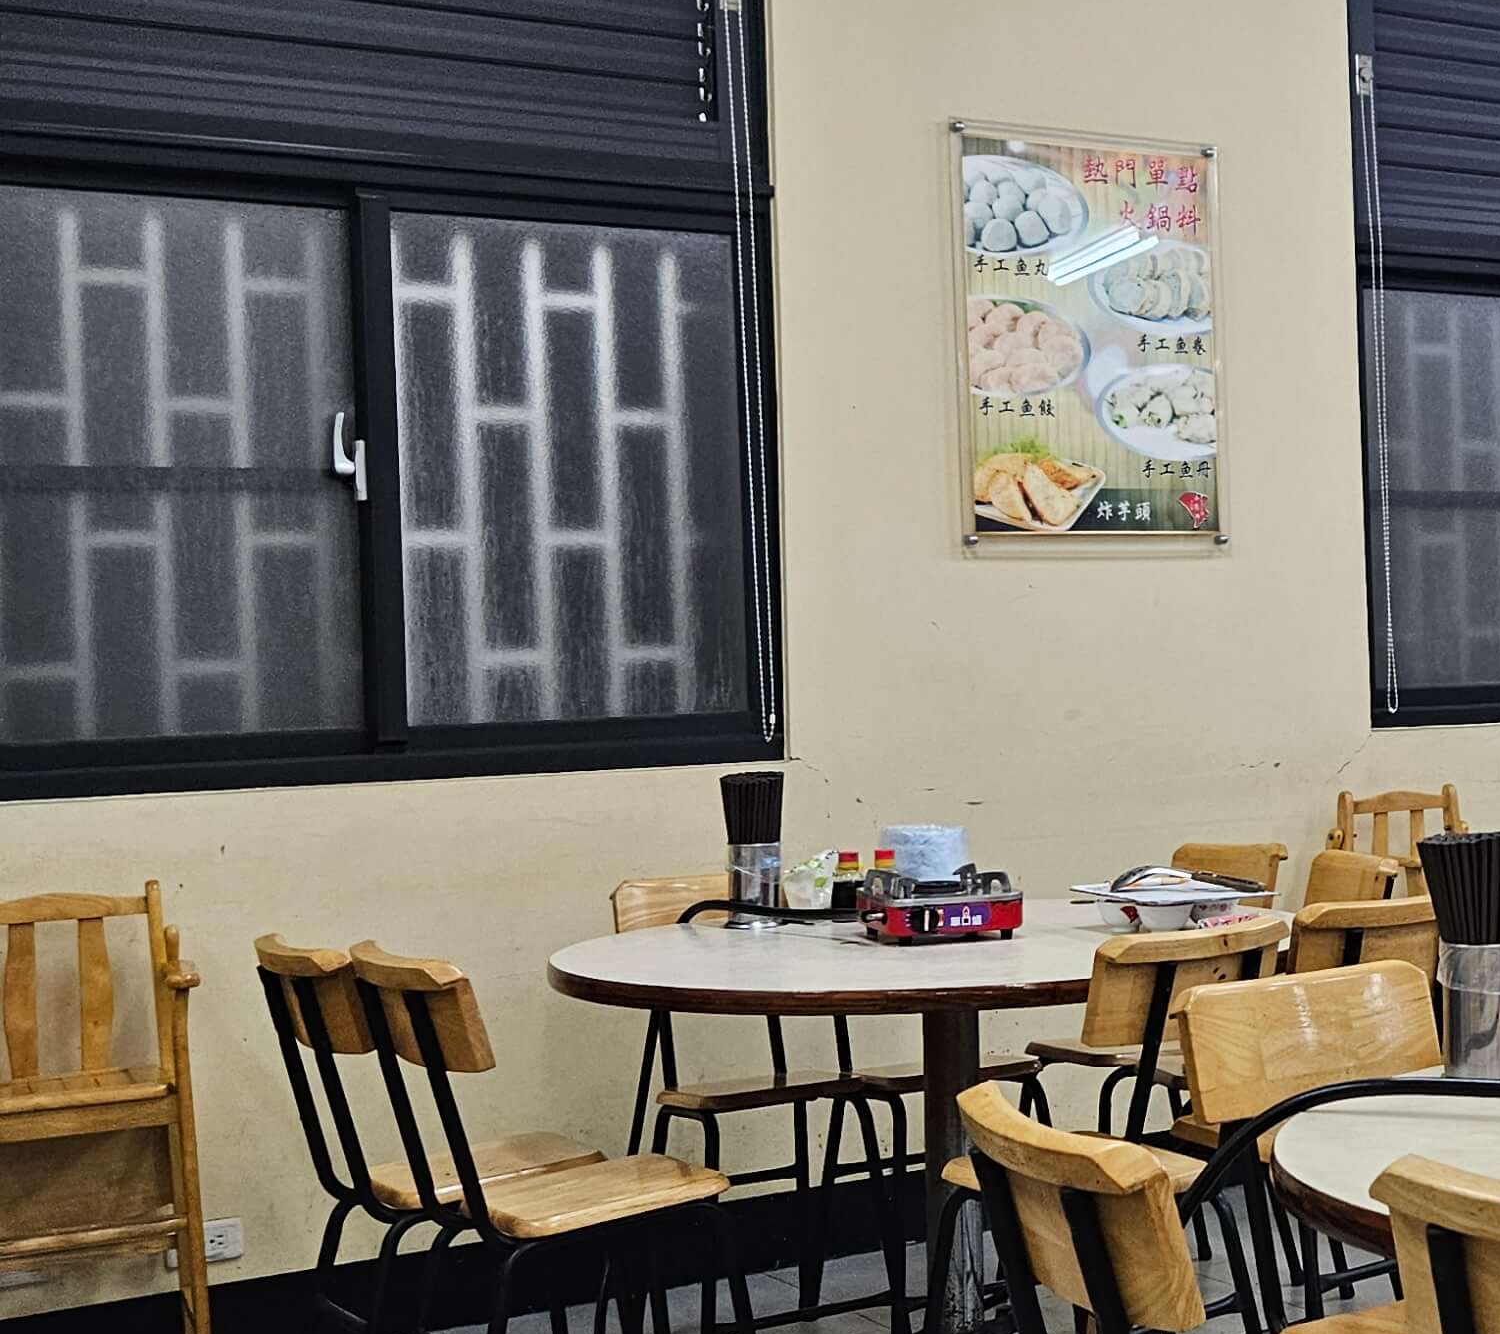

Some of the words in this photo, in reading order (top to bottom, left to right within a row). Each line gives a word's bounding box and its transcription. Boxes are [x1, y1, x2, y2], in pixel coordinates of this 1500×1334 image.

[1083, 154, 1198, 193] 熱門單點
[1119, 199, 1201, 236] 火鍋料
[1096, 499, 1151, 521] 炸芋頭
